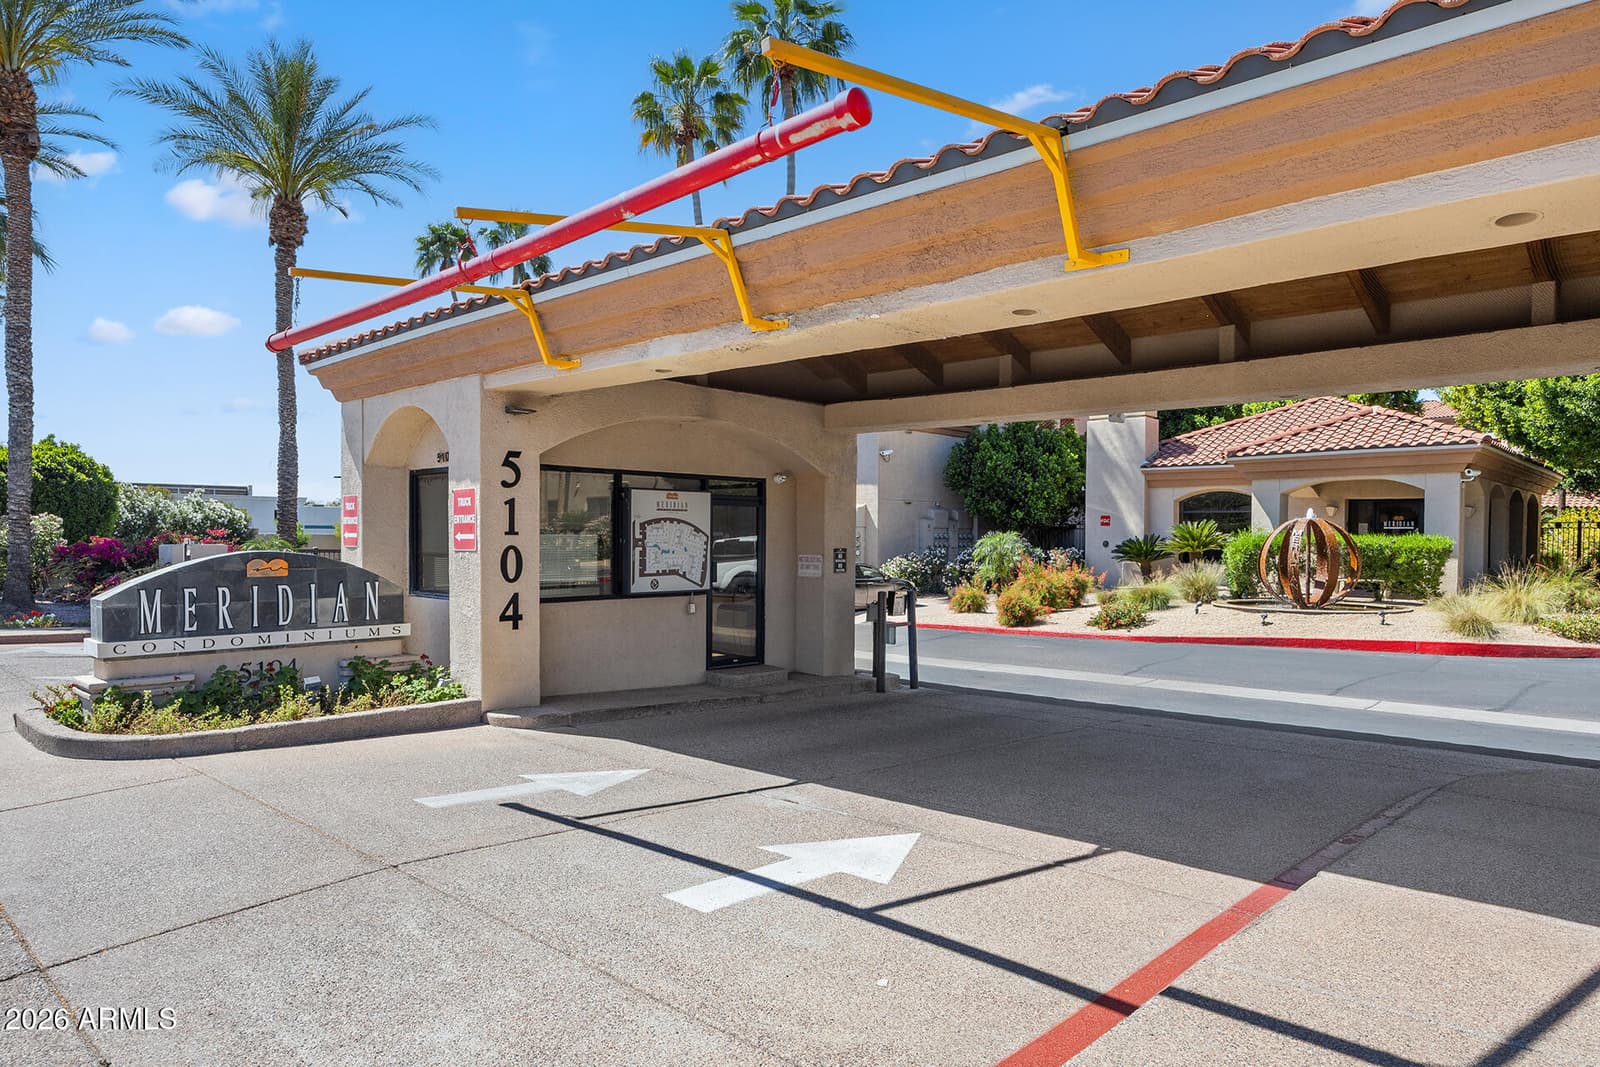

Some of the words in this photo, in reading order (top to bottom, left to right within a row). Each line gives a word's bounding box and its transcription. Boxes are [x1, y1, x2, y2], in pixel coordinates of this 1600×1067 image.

[457, 496, 472, 507] TRUCK
[499, 450, 523, 630] 5104
[138, 581, 380, 635] MERIDIAN
[112, 625, 403, 656] CONDOMINIUMS
